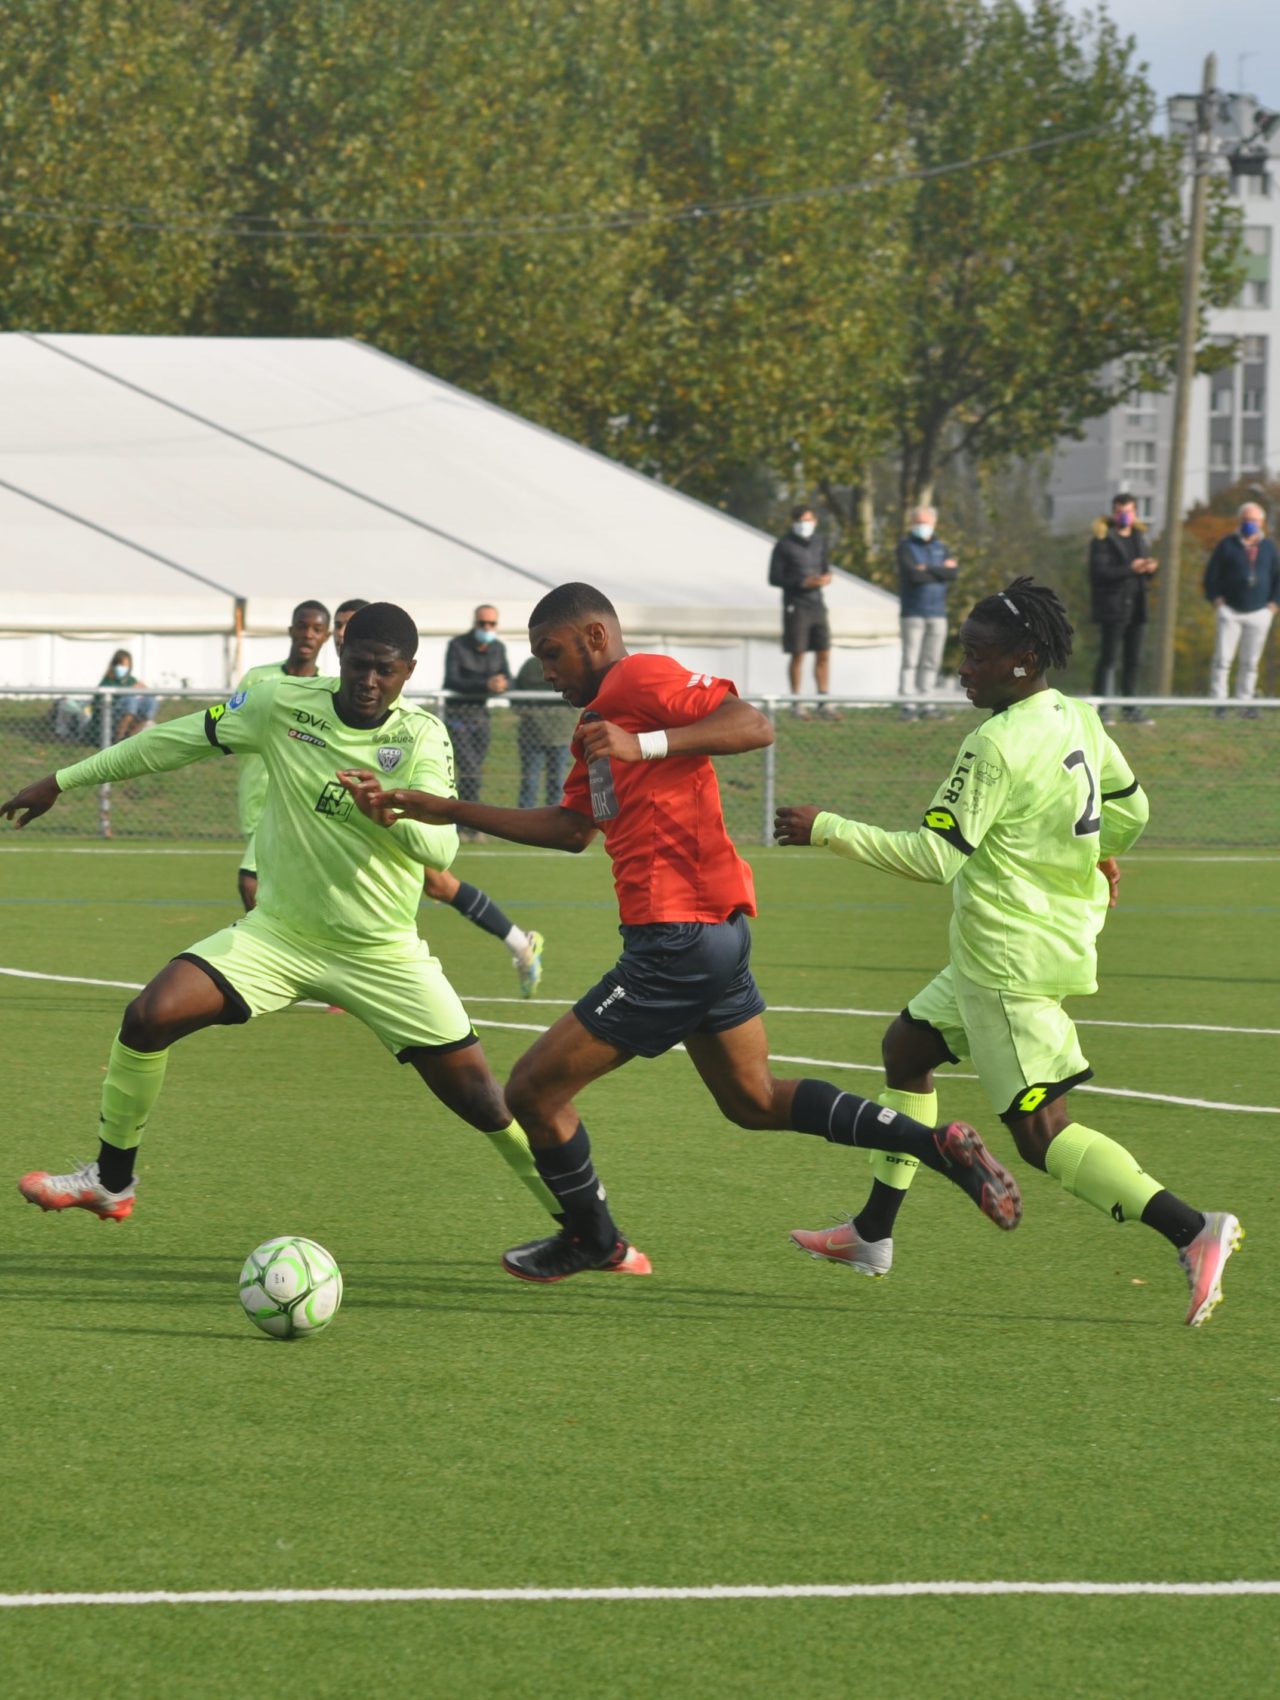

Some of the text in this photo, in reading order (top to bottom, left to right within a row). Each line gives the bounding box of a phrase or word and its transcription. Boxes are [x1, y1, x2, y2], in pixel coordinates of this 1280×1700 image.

[296, 733, 325, 746] LOTTO
[944, 766, 969, 804] LCR
[1062, 748, 1101, 837] 2
